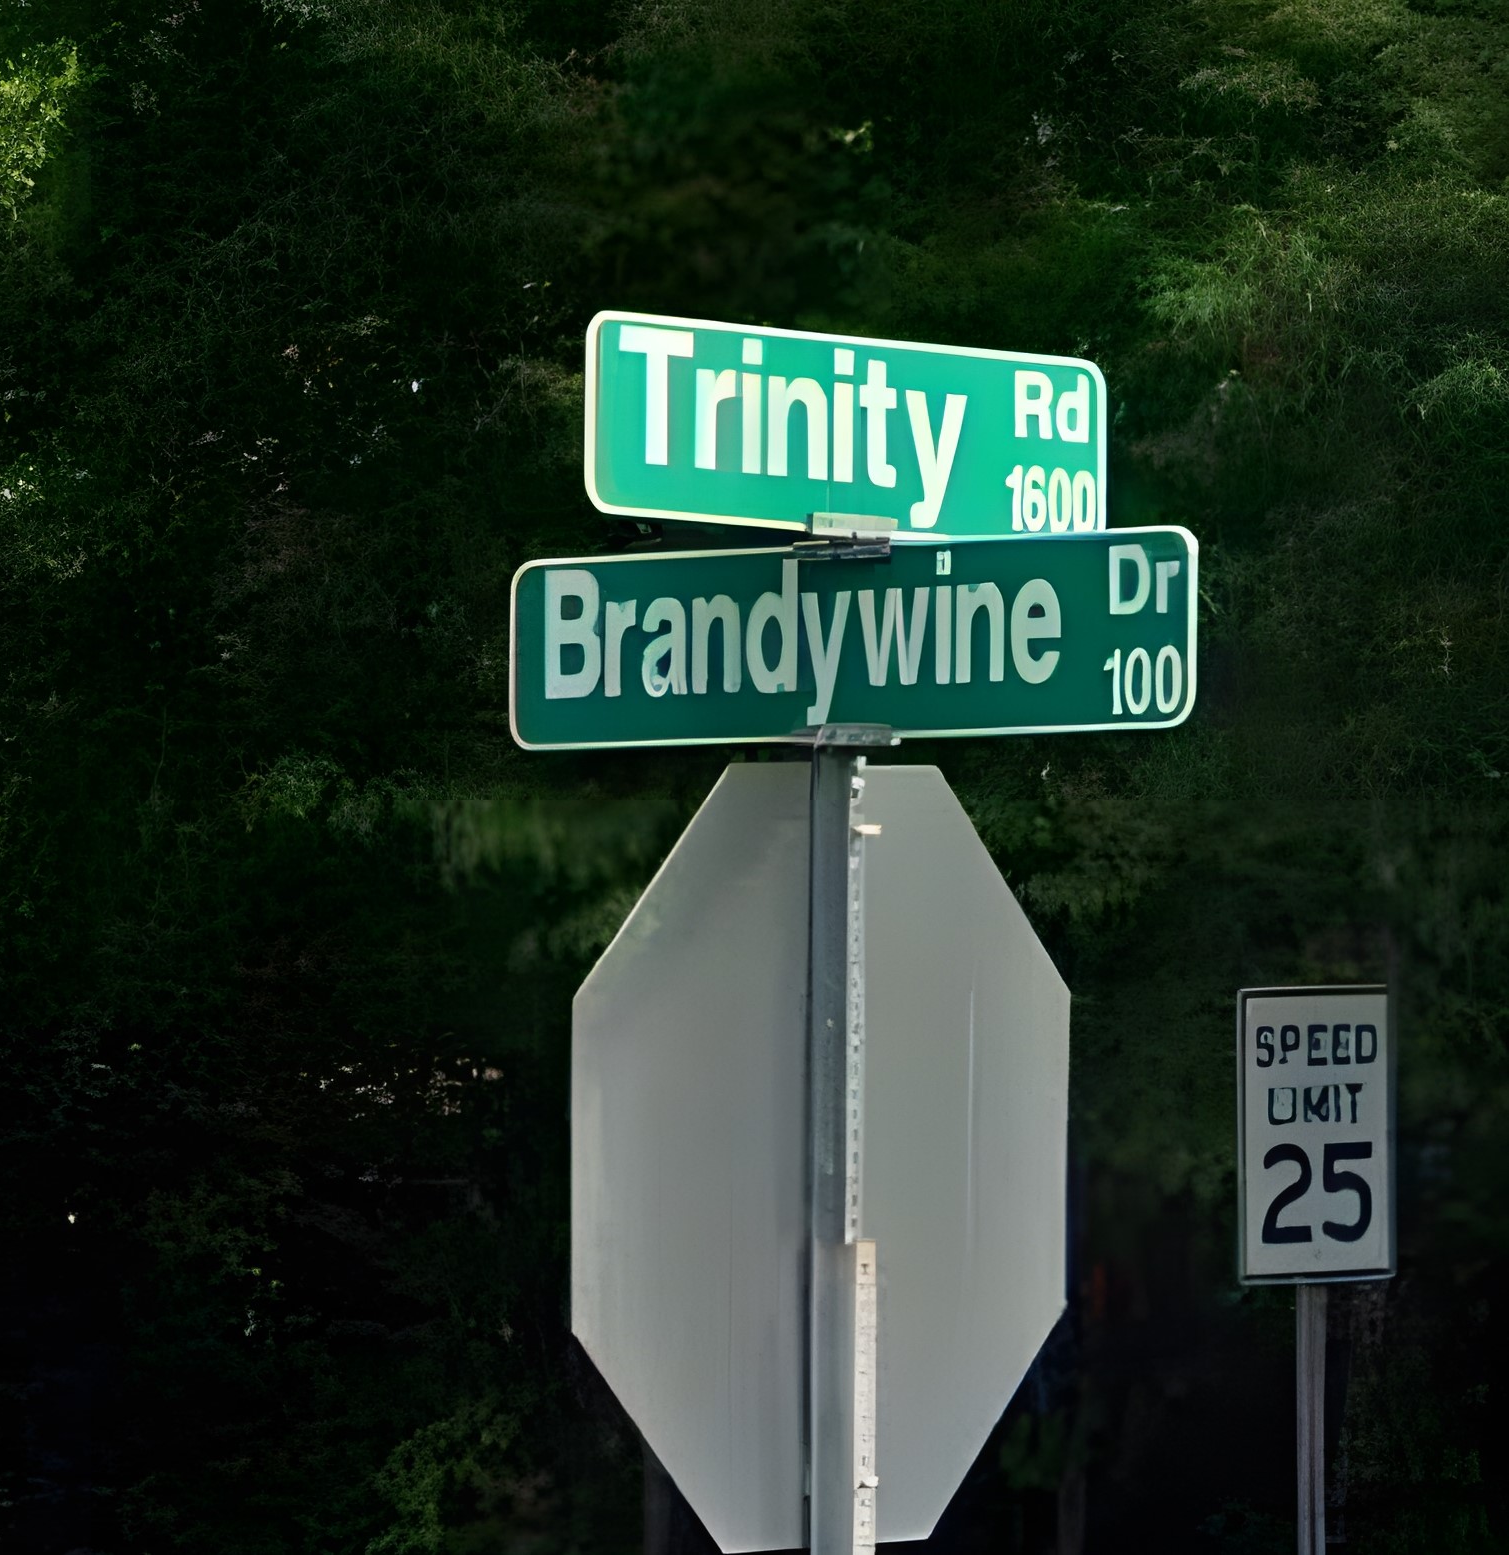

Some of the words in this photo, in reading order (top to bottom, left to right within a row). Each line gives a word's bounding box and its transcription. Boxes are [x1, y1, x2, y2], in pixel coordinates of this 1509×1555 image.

[619, 324, 968, 528] Trinity
[1014, 370, 1089, 443] Rd
[1005, 465, 1095, 533] 1600
[545, 550, 1062, 726] Brandywine
[1109, 544, 1181, 615] Dr
[1104, 645, 1181, 715] 100
[1256, 1023, 1377, 1067] SPEED
[1261, 1142, 1373, 1244] 25
